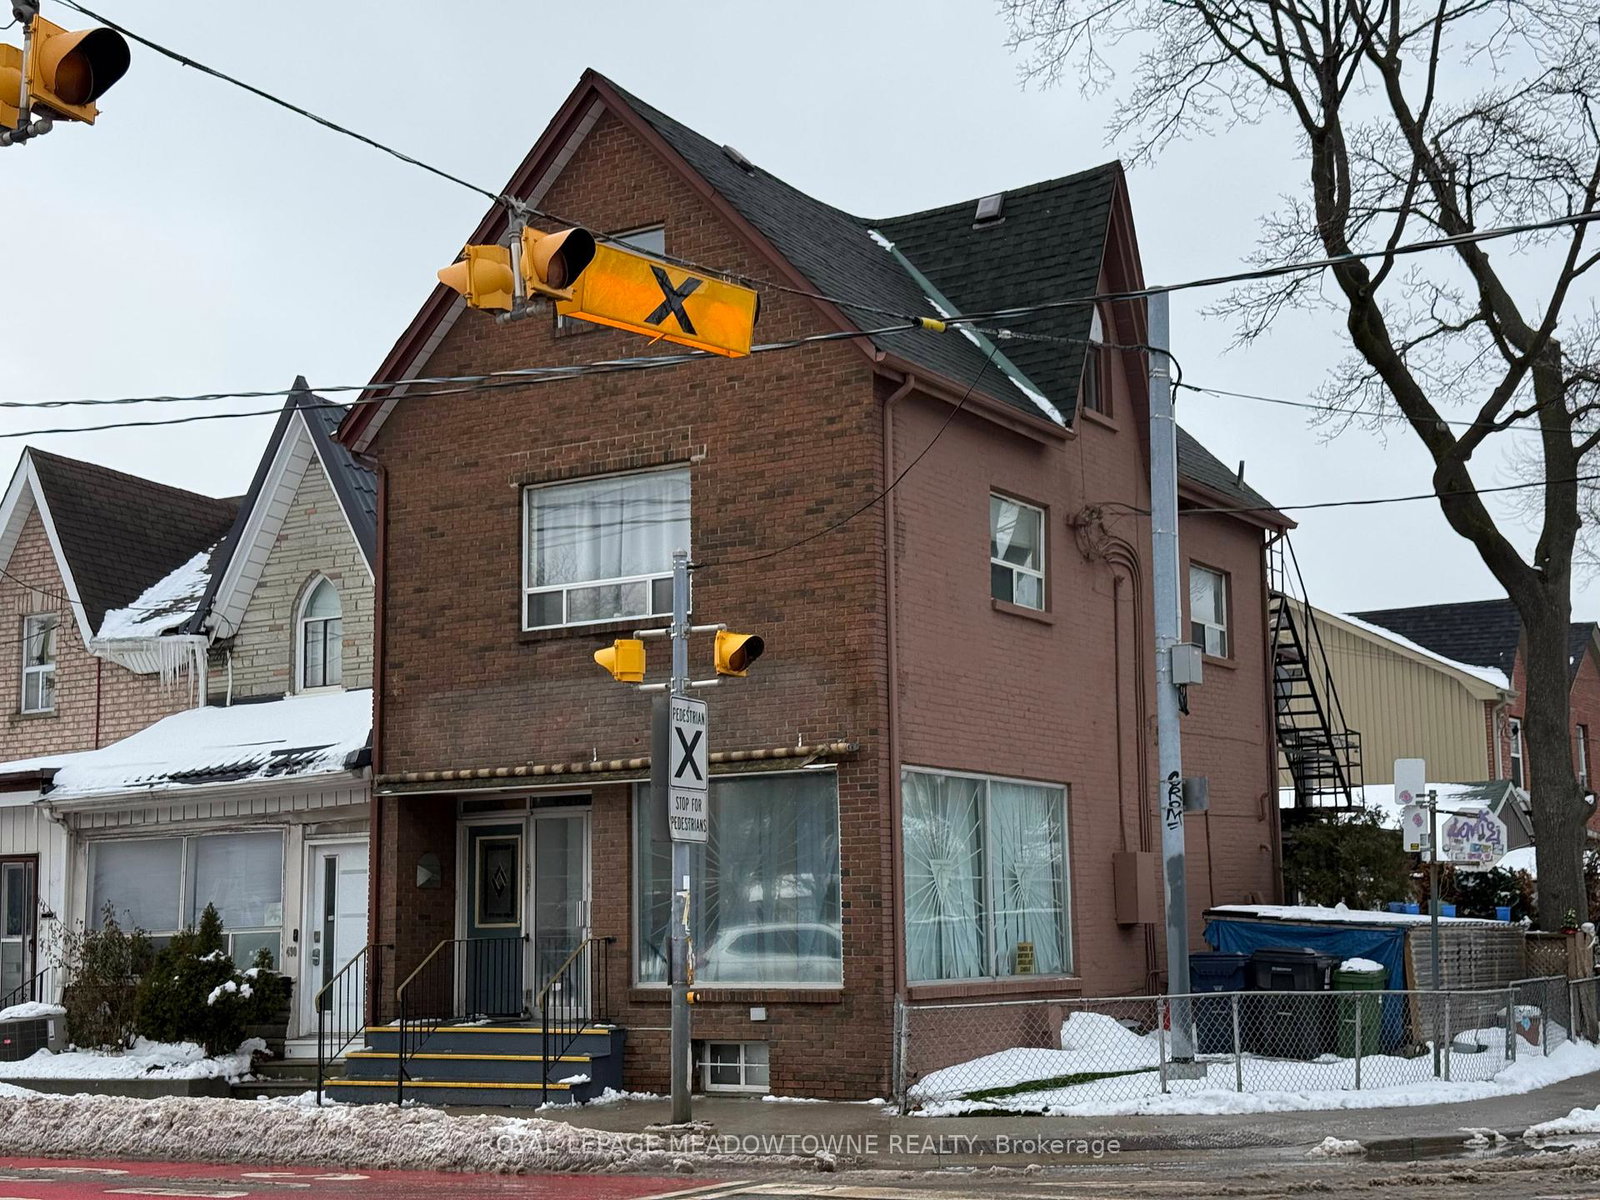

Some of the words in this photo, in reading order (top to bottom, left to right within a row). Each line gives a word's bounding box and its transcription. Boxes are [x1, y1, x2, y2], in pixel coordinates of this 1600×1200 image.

[644, 264, 703, 335] X
[672, 707, 705, 725] PEDESTRIAN
[674, 727, 703, 781] X
[675, 796, 690, 811] STOP
[691, 798, 703, 812] FOR
[670, 816, 707, 833] PEDESTRIANS
